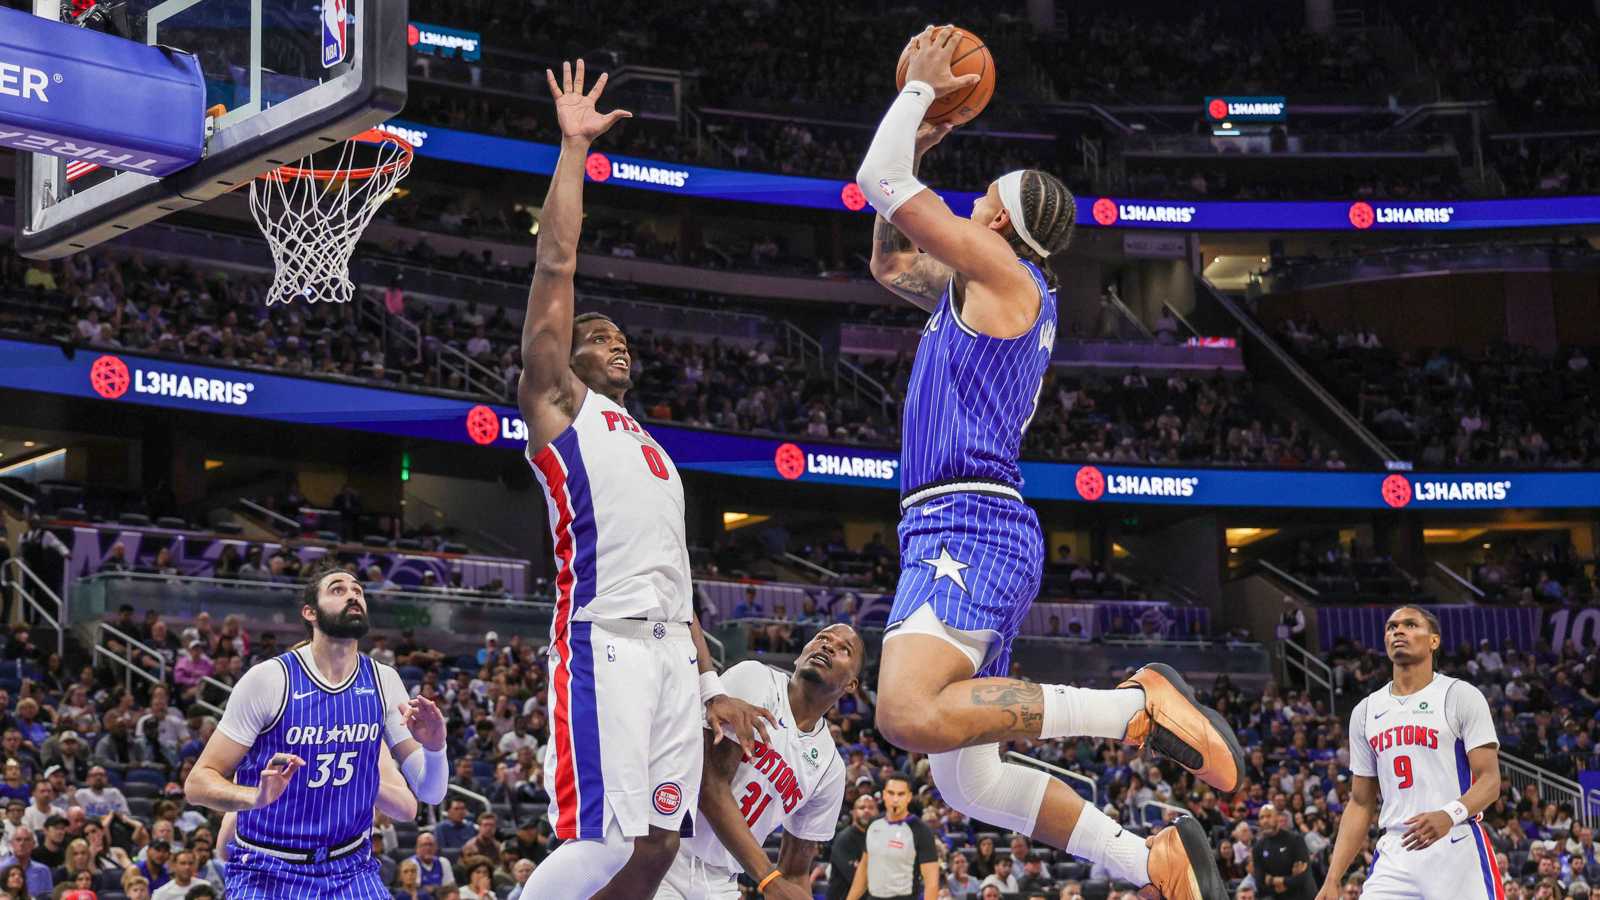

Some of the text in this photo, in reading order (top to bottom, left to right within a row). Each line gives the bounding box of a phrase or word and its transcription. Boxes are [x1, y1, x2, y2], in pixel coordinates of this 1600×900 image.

[325, 43, 337, 62] NBA
[308, 751, 358, 788] 35
[1393, 755, 1413, 789] 9
[740, 781, 773, 828] 31
